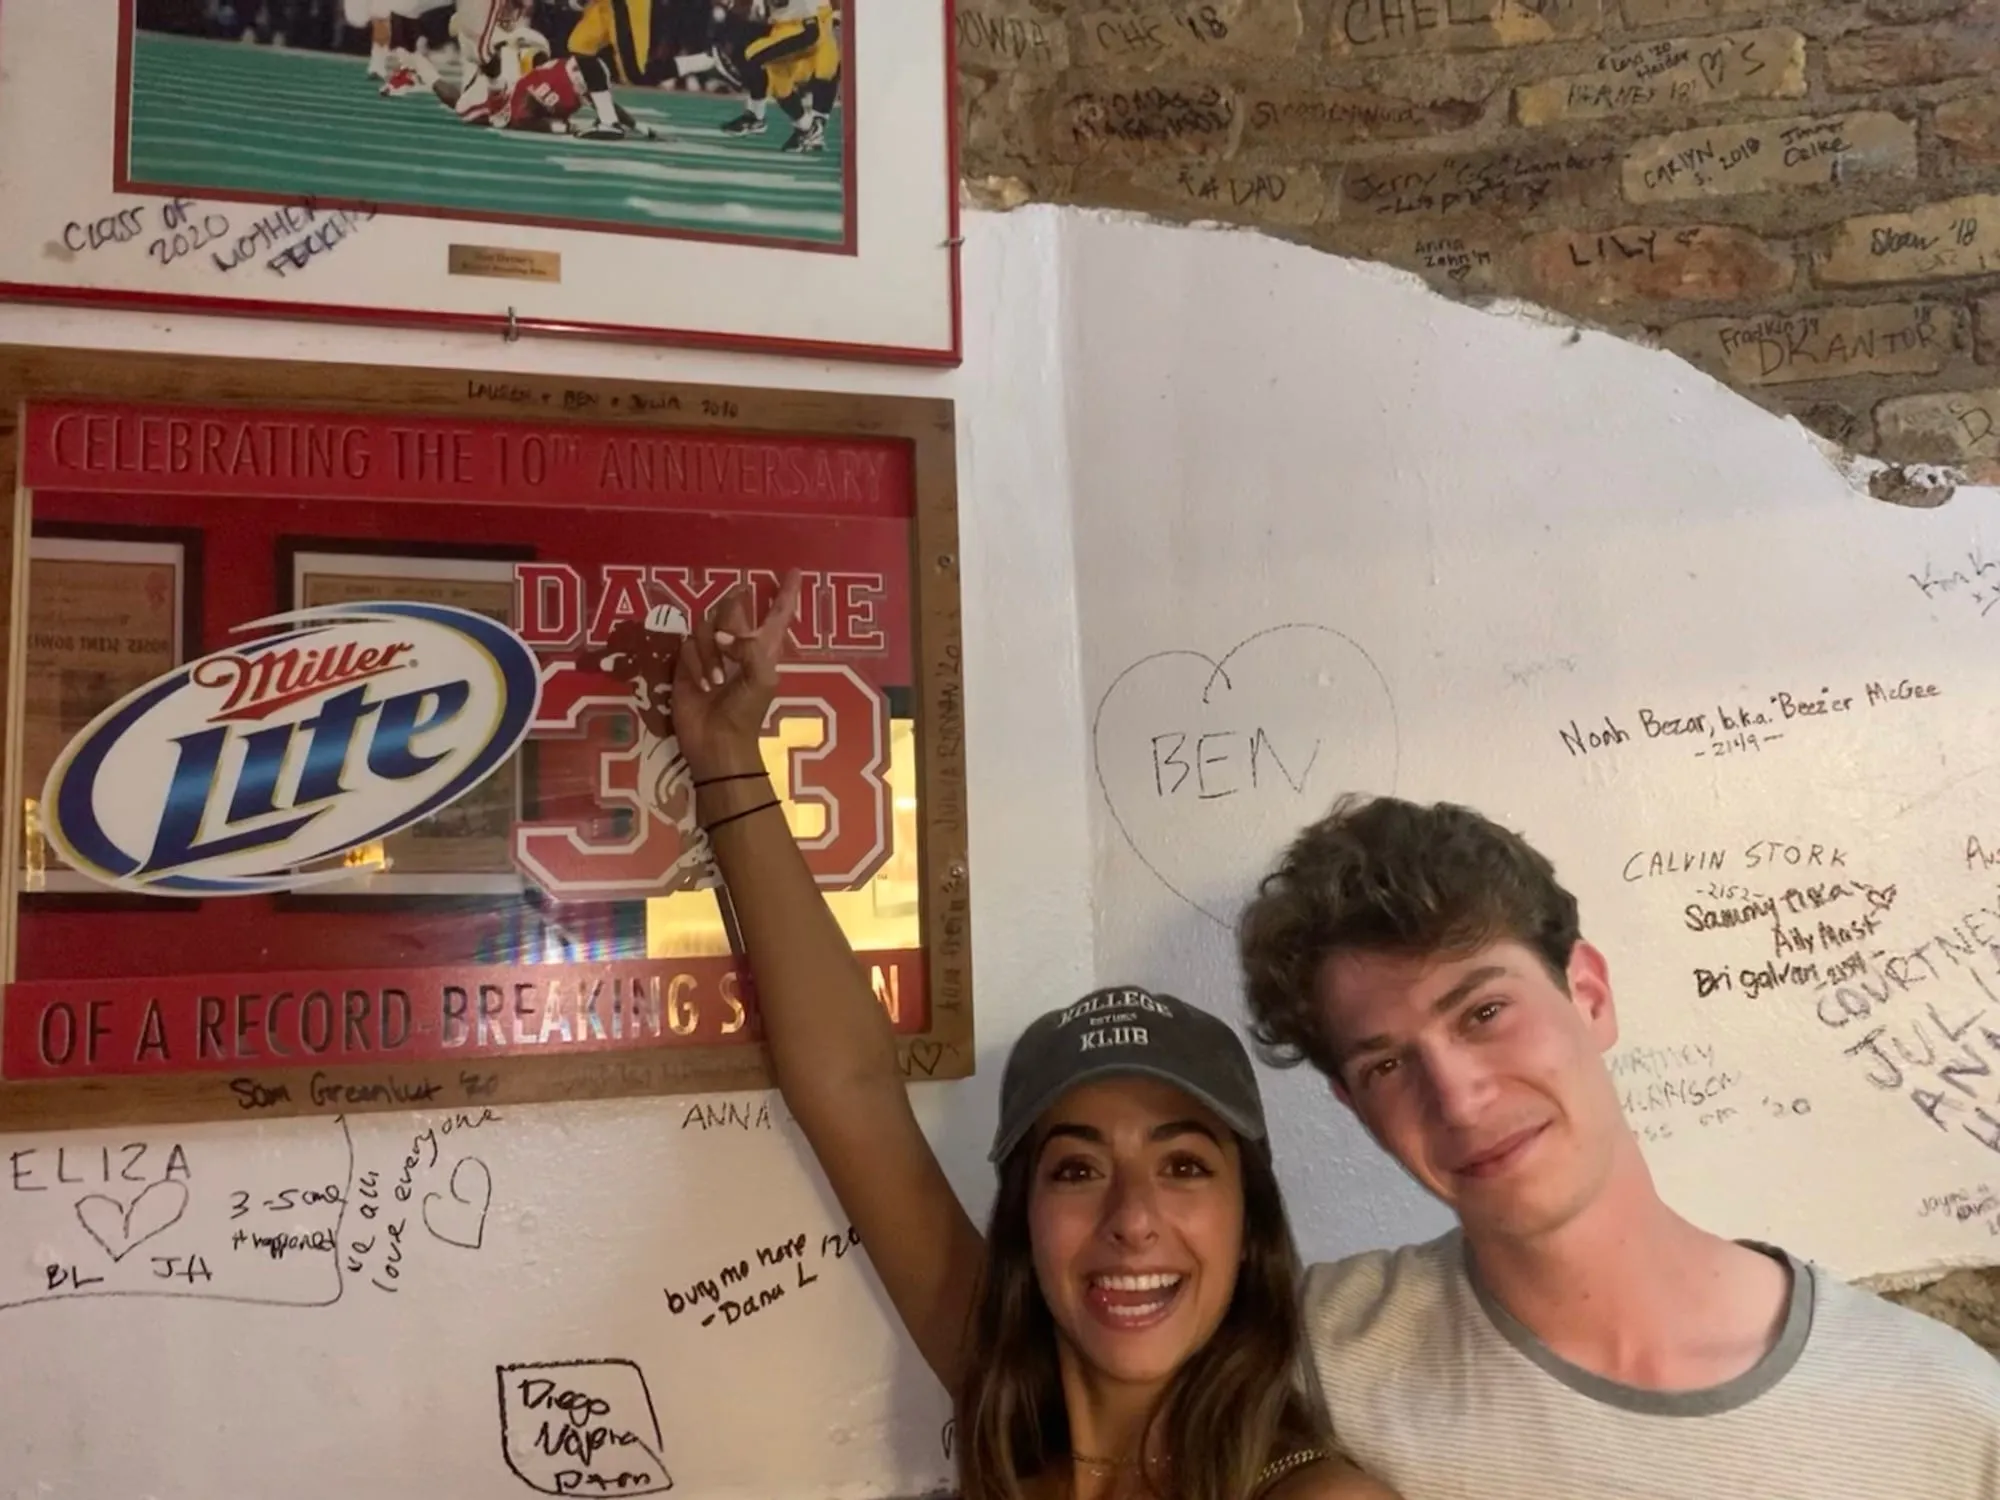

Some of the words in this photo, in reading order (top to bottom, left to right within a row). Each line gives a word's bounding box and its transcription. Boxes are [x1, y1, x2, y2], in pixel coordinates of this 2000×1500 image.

[150, 213, 229, 265] 2020
[1568, 230, 1658, 266] LILY
[48, 412, 370, 480] CELEBRATING
[390, 430, 473, 484] THE
[601, 438, 888, 501] ANNIVERSARY
[192, 640, 415, 715] Miller
[1559, 717, 1630, 757] Noah
[122, 679, 470, 879] Lite
[1151, 727, 1321, 799] BEN
[1623, 848, 1727, 883] CALVIN
[1744, 841, 1848, 869] STORK
[39, 1000, 112, 1067] OF
[135, 997, 171, 1062] A
[197, 988, 412, 1059] RECORD
[441, 972, 700, 1048] BREAKING
[1079, 1026, 1150, 1053] KLUB
[1843, 942, 2000, 1089] JULI
[681, 1101, 772, 1130] ANNA
[10, 1144, 192, 1192] ELIZA
[517, 1378, 611, 1428] Diego
